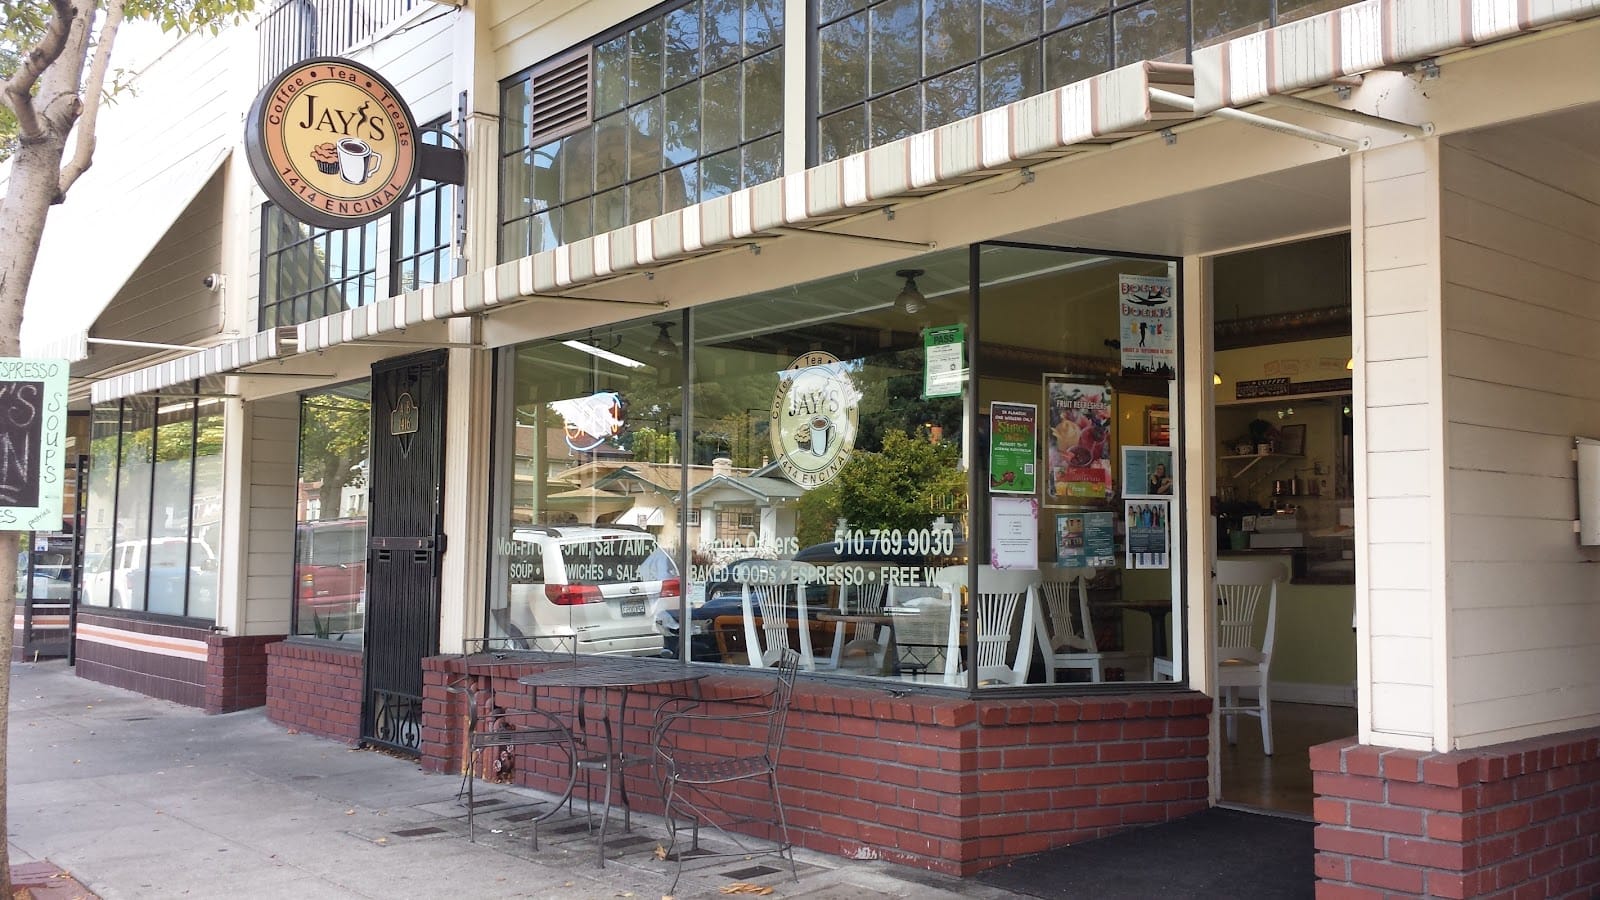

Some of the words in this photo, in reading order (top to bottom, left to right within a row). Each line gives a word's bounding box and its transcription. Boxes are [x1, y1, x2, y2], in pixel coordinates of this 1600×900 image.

[269, 77, 304, 126] Coffee
[327, 66, 357, 82] Tea
[380, 93, 409, 147] Treats
[299, 93, 386, 142] JAY'S
[282, 167, 317, 203] 1414
[325, 184, 402, 214] ENCINAL
[933, 334, 955, 344] PASS
[0, 361, 59, 379] SPRESSO
[804, 355, 823, 366] Tea
[1056, 399, 1073, 409] FRUIT
[43, 392, 63, 484] SOUPS
[778, 453, 798, 479] 1414
[802, 447, 850, 484] ENCINAL
[496, 536, 535, 556] Mon-Fri
[595, 538, 615, 556] Sat
[618, 537, 677, 556] 7AM-3
[833, 528, 954, 556] 510.769.9030
[510, 562, 533, 579] SOUP
[616, 564, 646, 582] SALA
[691, 564, 729, 583] BAKED
[732, 564, 777, 584] GOODS
[790, 565, 864, 586] ESPRESSO
[880, 566, 920, 587] FREE
